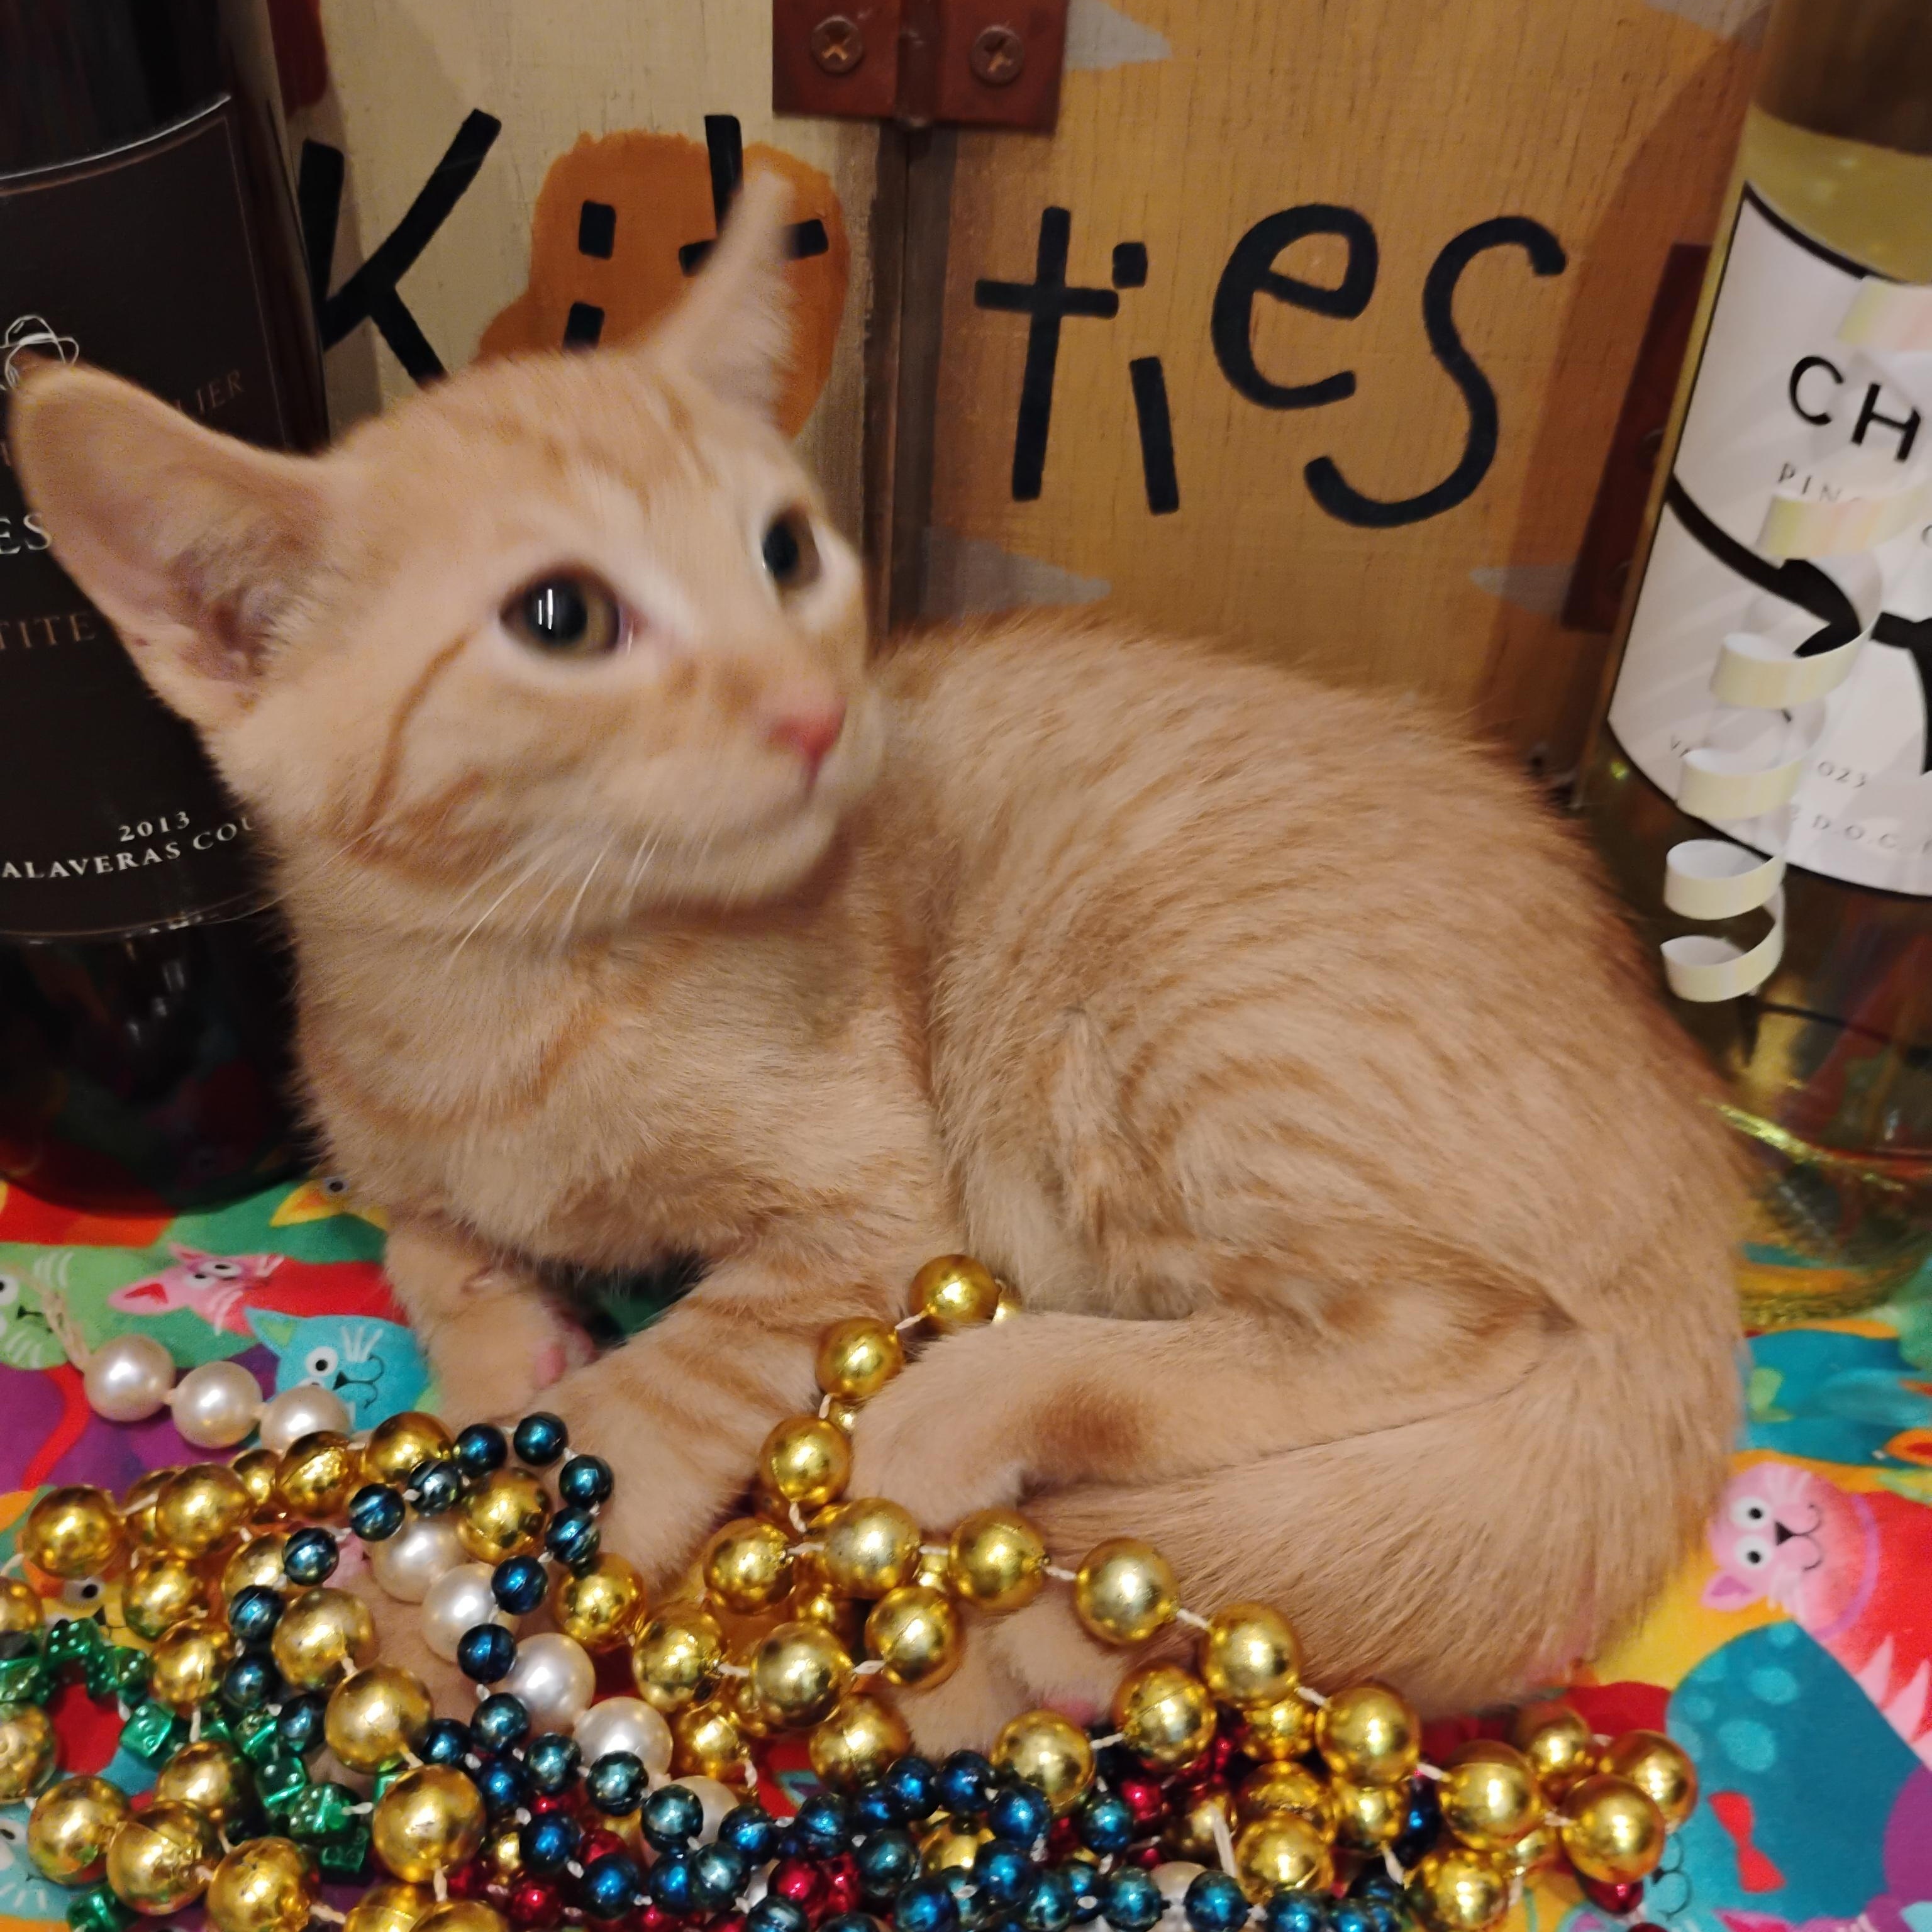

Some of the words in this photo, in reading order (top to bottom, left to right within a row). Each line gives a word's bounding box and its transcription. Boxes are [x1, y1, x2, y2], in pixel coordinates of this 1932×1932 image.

[1777, 461, 1864, 503] PIN
[118, 810, 191, 842] 2013
[1, 841, 182, 879] ALAVERAS
